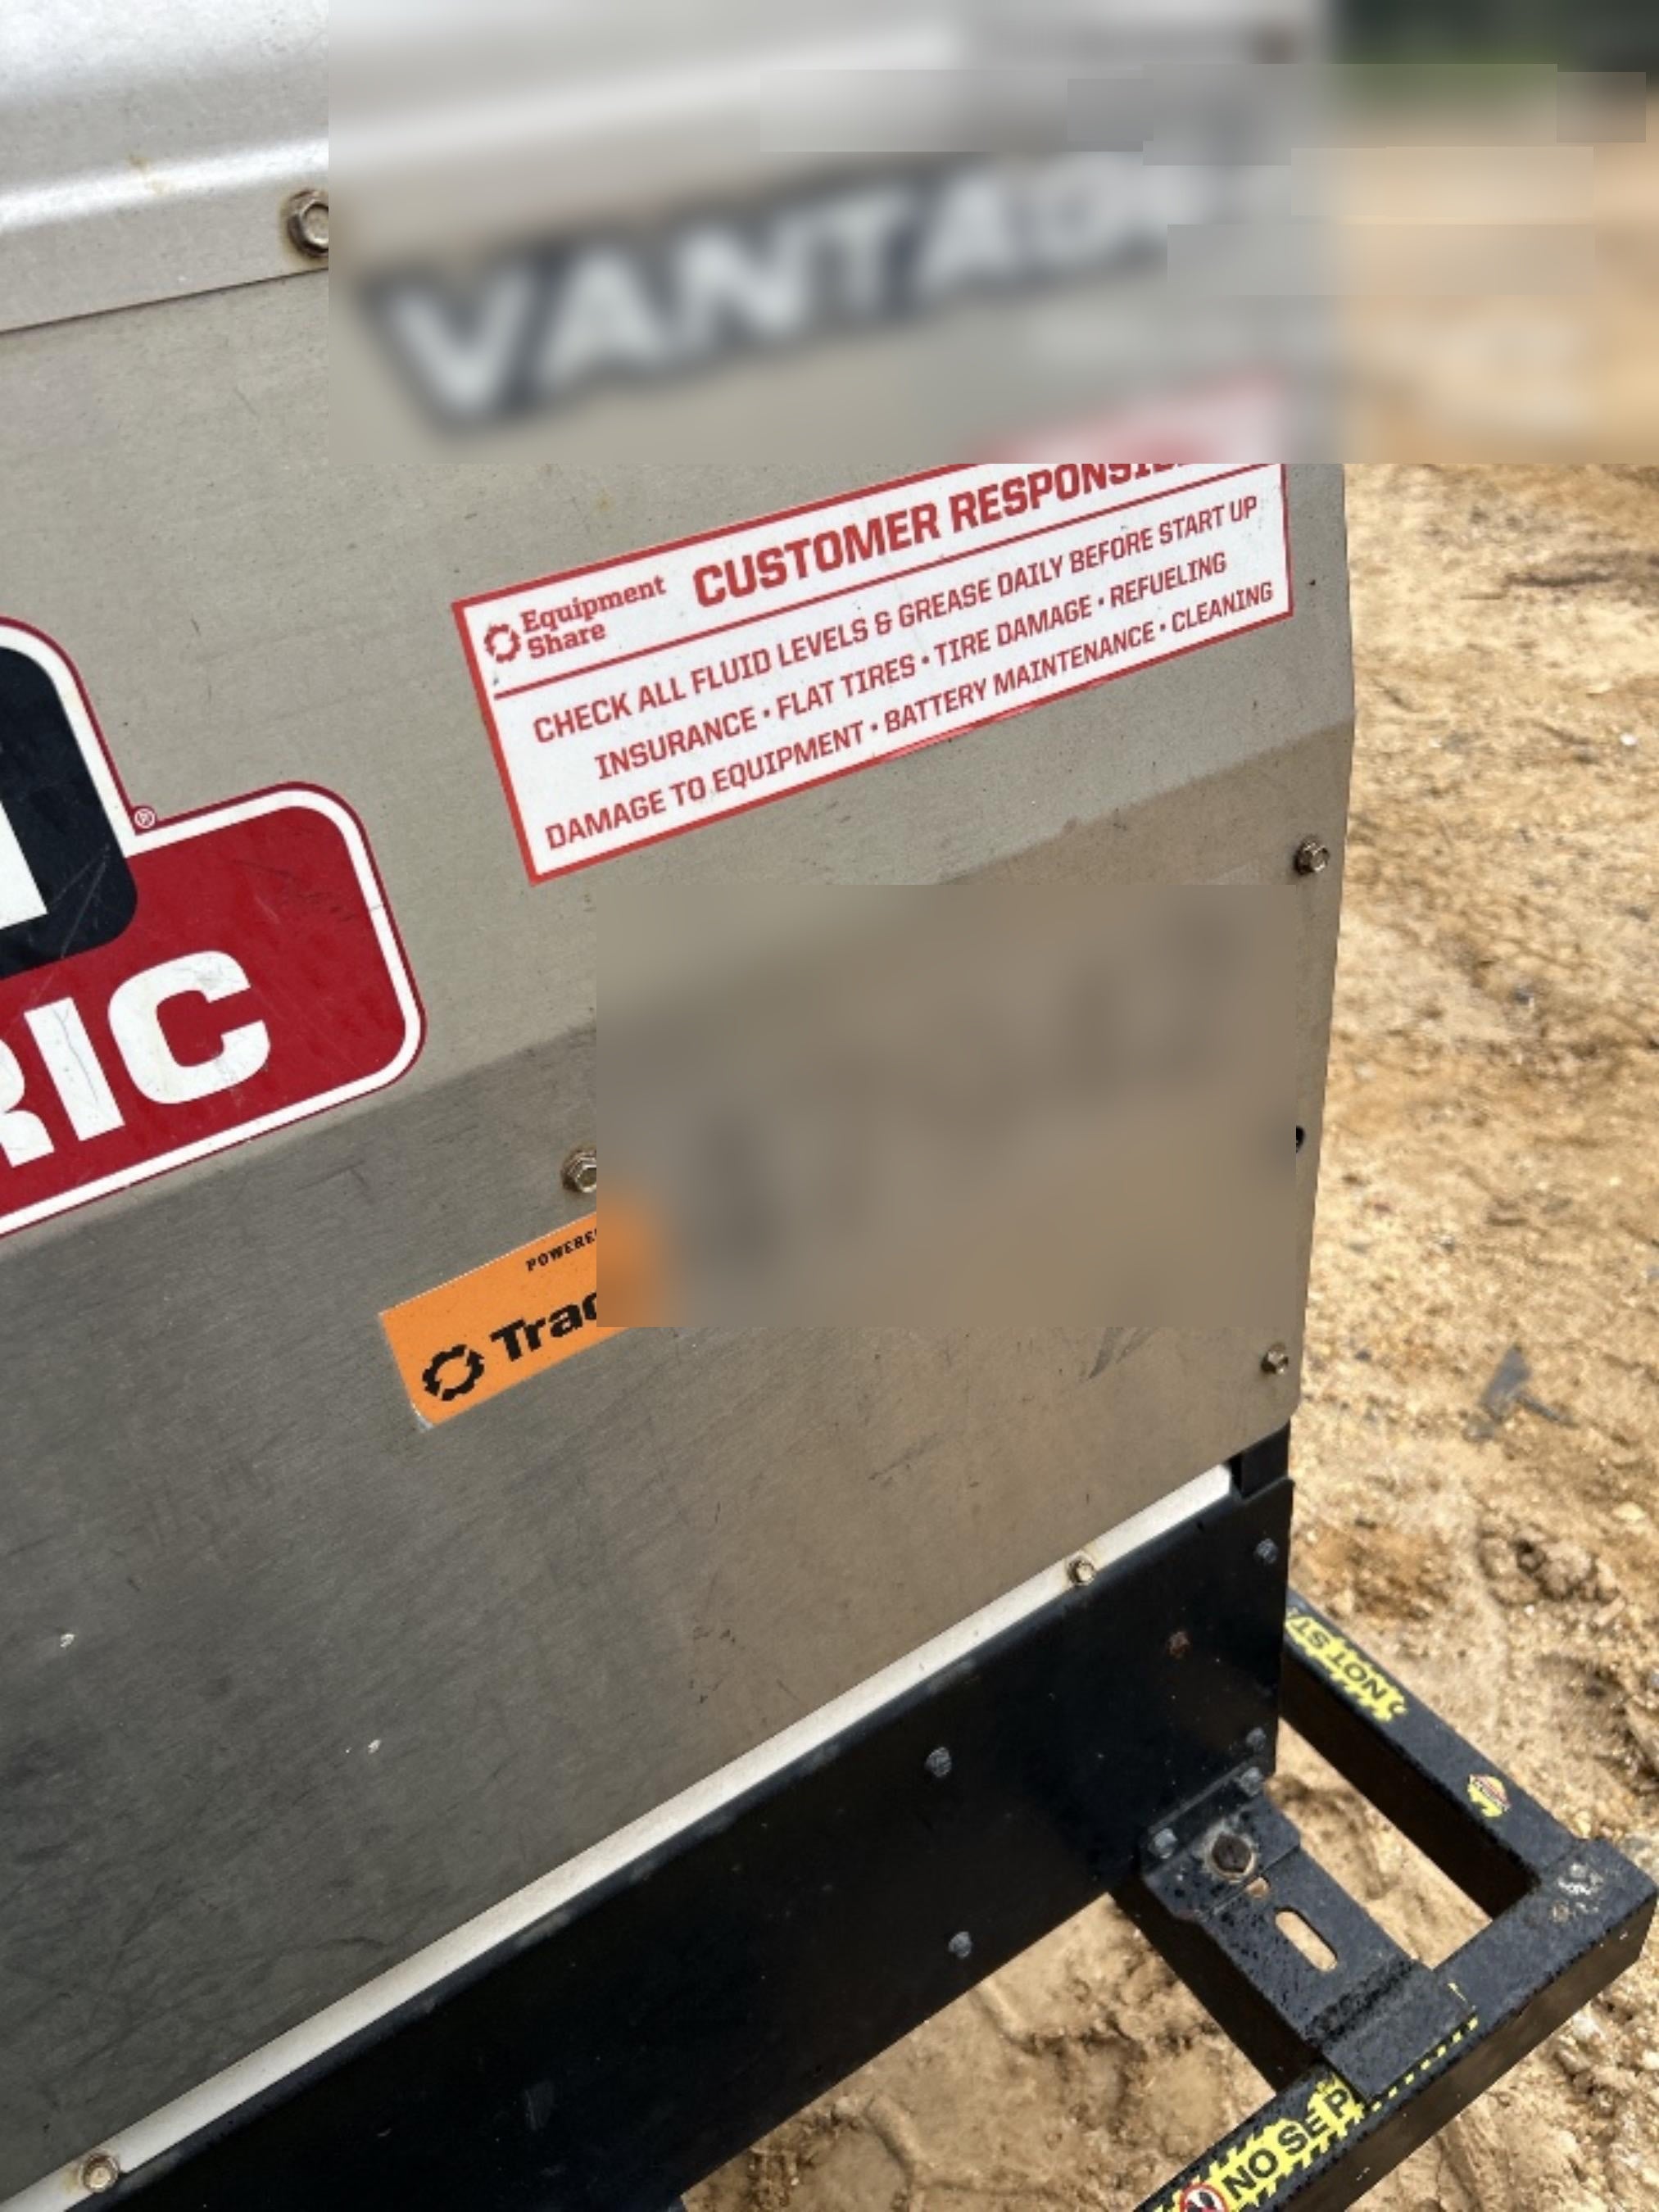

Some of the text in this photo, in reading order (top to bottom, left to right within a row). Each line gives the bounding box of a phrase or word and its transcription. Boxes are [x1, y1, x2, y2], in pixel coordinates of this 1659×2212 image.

[692, 502, 940, 607] CUSTOMER
[522, 576, 665, 633] Equipment
[528, 623, 605, 659] Share
[533, 496, 1258, 743] CHECK ALL FLUID LEVELS & GREASE DAILY BEFORE START UP
[595, 551, 1227, 779] INSURANCE FLAT TIRES TIRE DAMAGE REFUELING
[545, 581, 1275, 850] DAMAGE TO EQUIPMENT BATTERY MAINTENANCE CLEANING
[526, 1229, 596, 1271] POWERE
[1221, 2148, 1278, 2201] NO
